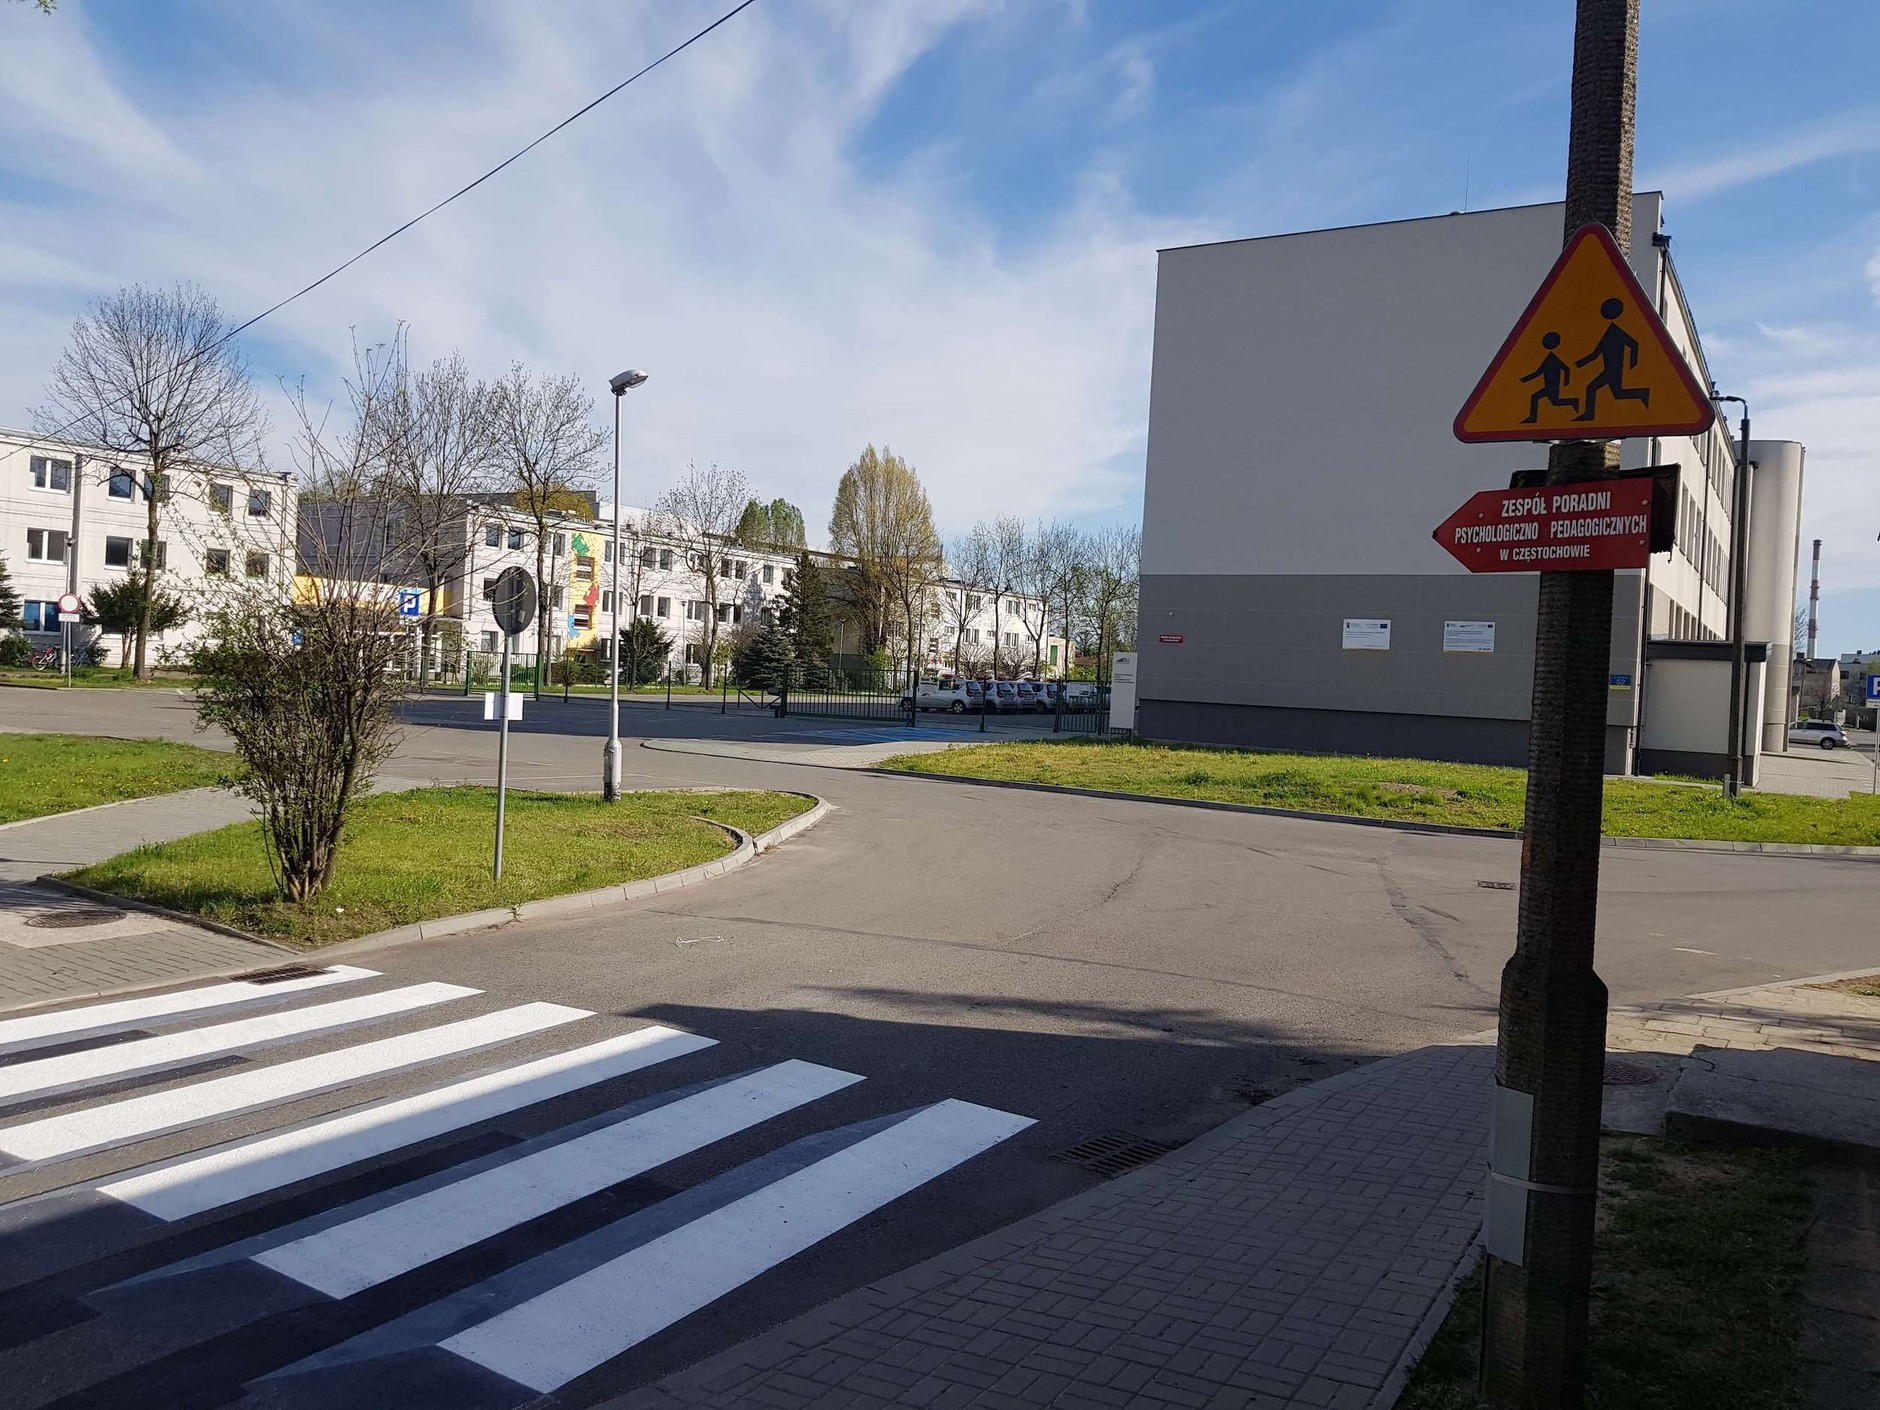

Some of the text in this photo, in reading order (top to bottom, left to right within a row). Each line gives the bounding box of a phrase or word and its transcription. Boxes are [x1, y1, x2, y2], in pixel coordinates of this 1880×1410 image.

[1501, 491, 1612, 518] ZESPÓŁ PORADNI
[1455, 515, 1647, 544] PSYCHOLOGICZNO PEDAGOGICZNYCH
[1499, 545, 1590, 562] W CZĘSTOCHOWIE
[404, 588, 416, 613] P
